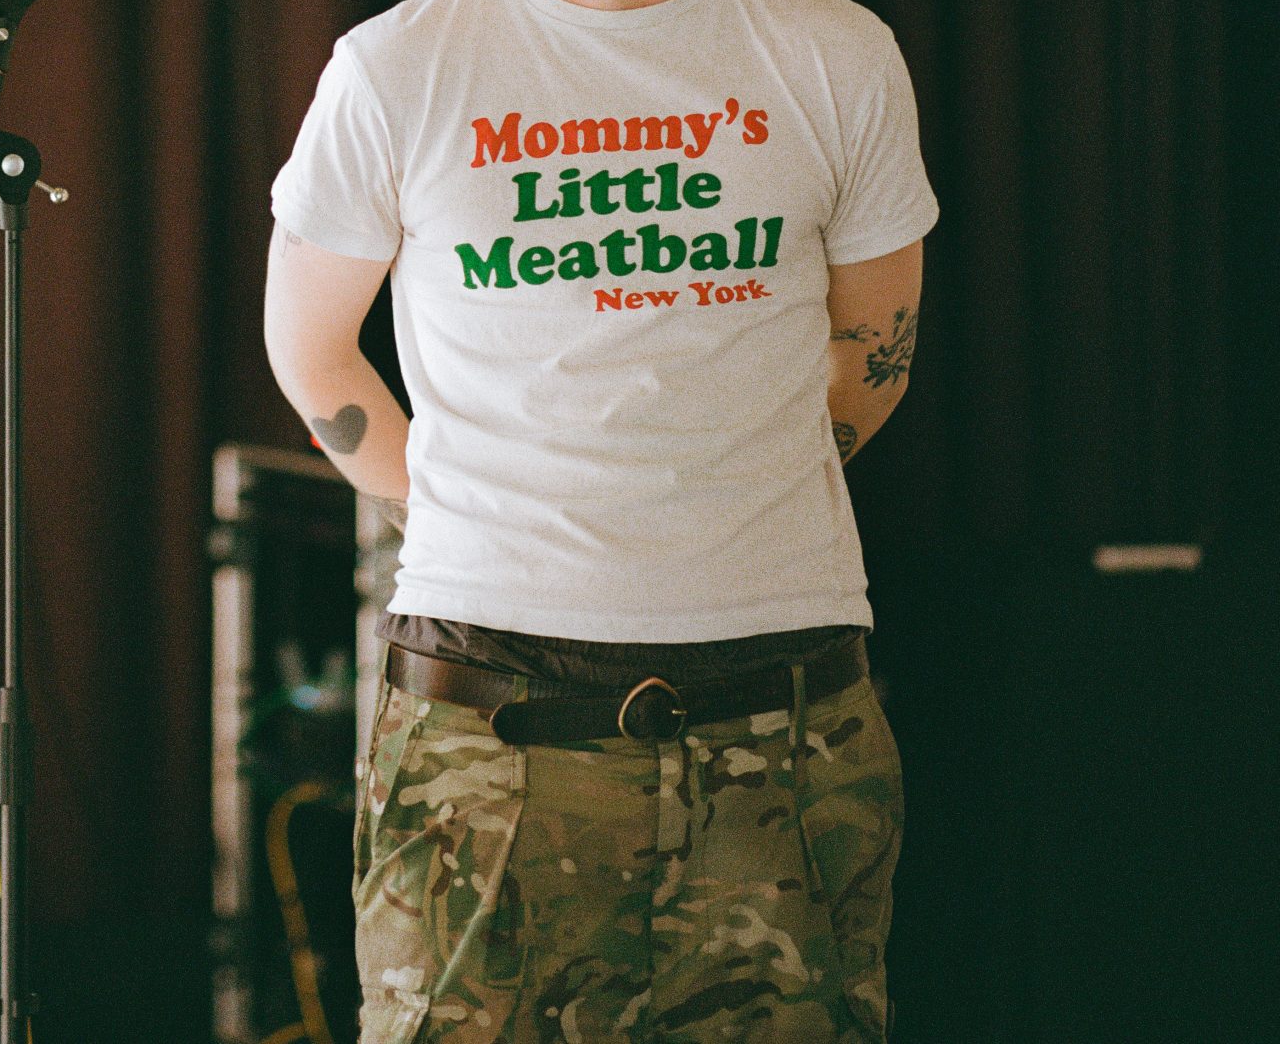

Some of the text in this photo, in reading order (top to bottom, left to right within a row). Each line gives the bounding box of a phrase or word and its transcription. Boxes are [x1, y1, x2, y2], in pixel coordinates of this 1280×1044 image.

[470, 97, 769, 168] Mommy's
[511, 162, 722, 222] Little
[454, 216, 784, 289] Meatball
[594, 279, 772, 312] New York
